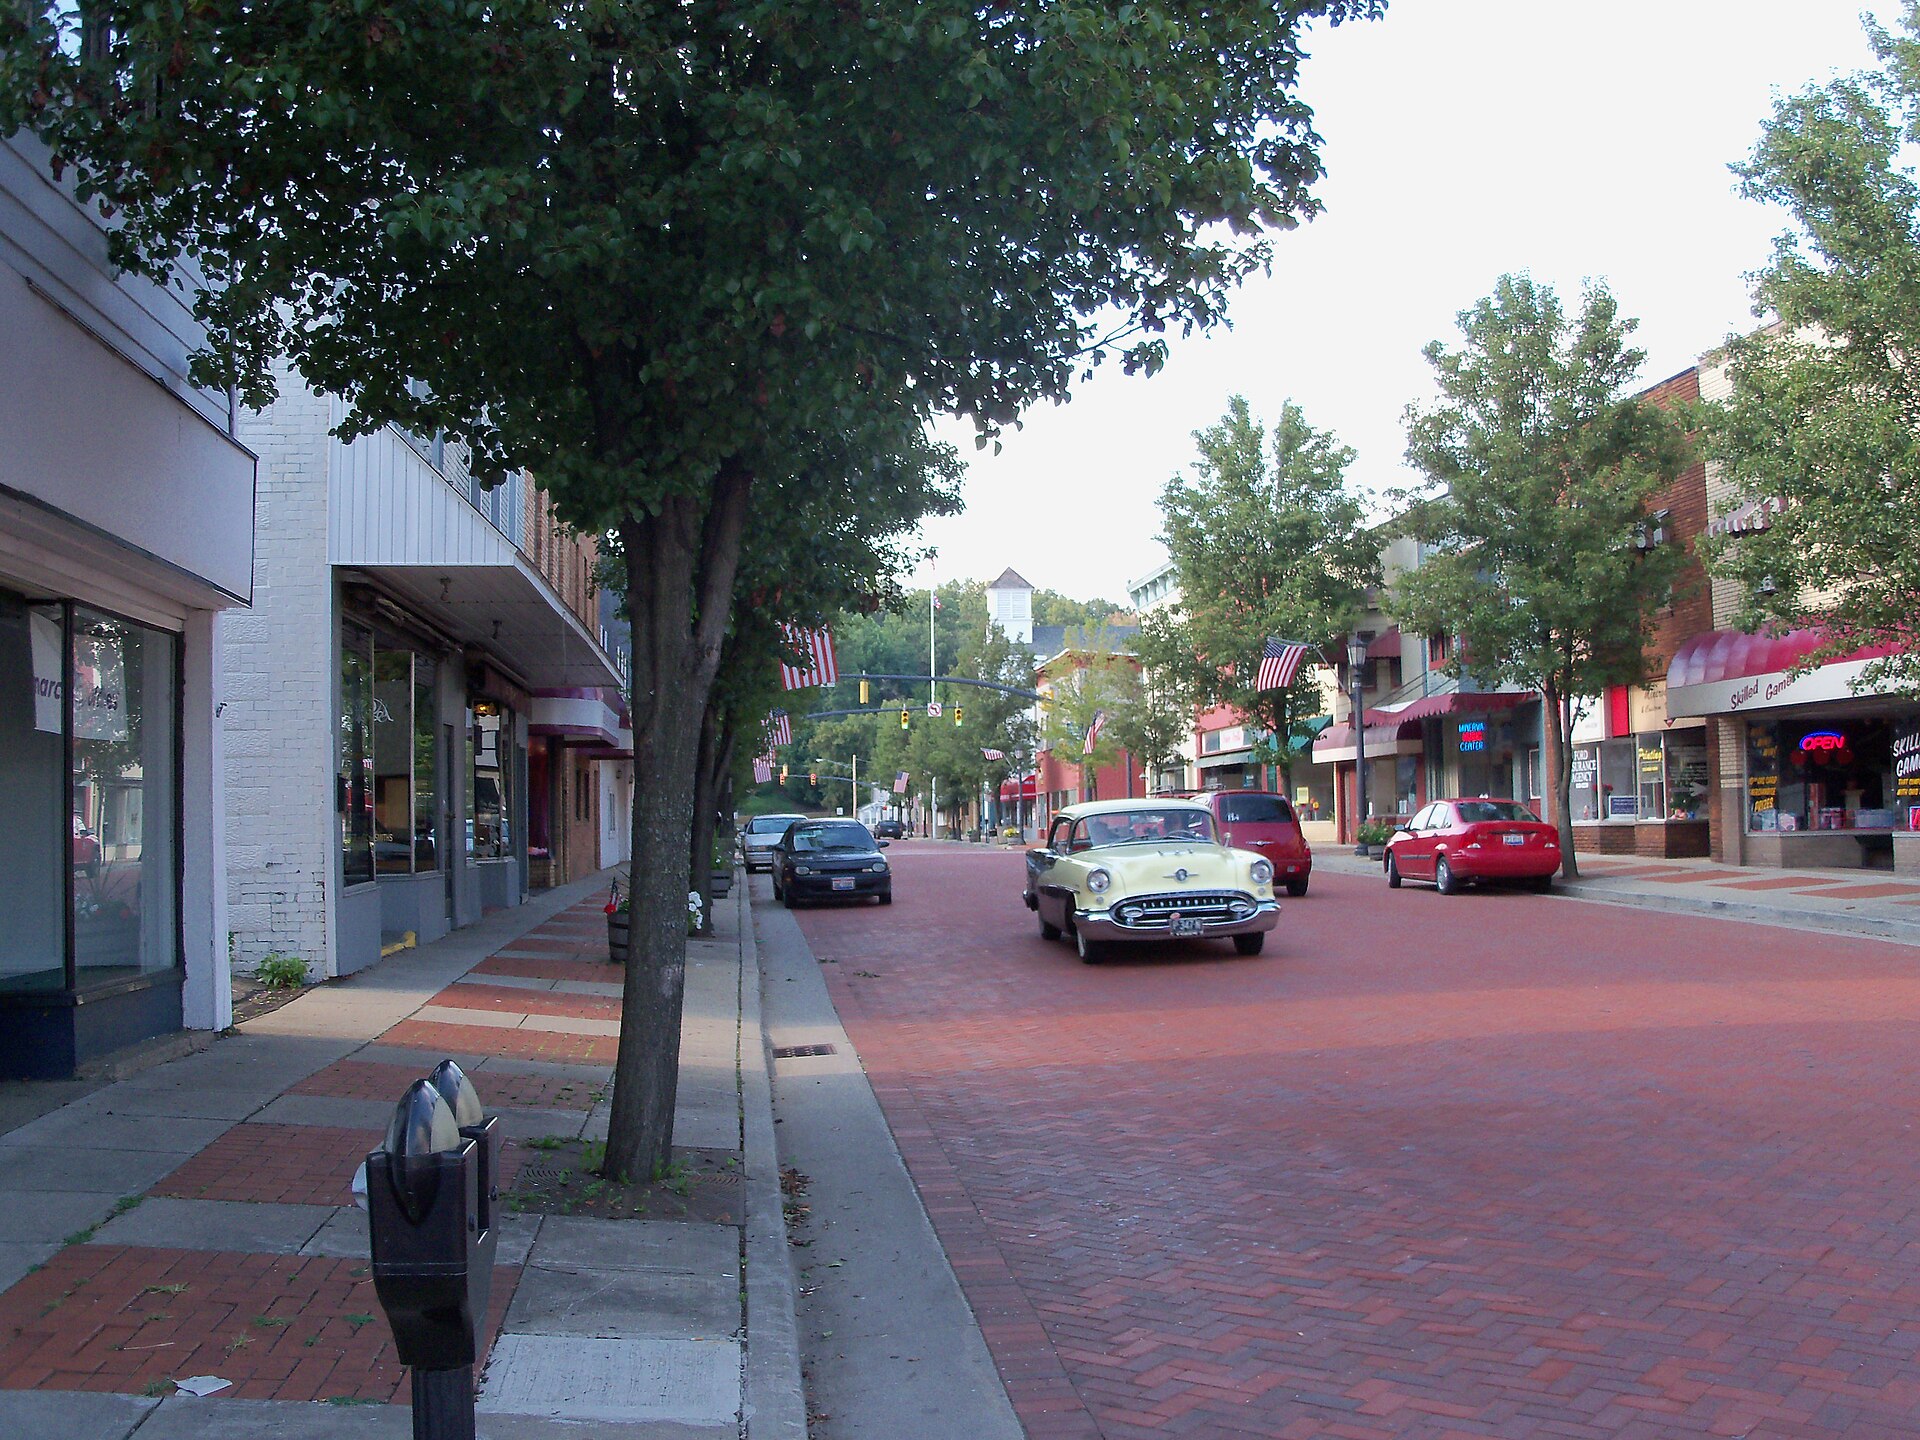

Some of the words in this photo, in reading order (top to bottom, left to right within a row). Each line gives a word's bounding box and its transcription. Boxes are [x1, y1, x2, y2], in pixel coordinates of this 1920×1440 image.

[1730, 679, 1758, 709] Skilled
[1458, 722, 1484, 732] MINERVA
[1460, 741, 1484, 751] CENTER
[1802, 736, 1844, 750] OPEN
[1893, 732, 1920, 757] SKILL
